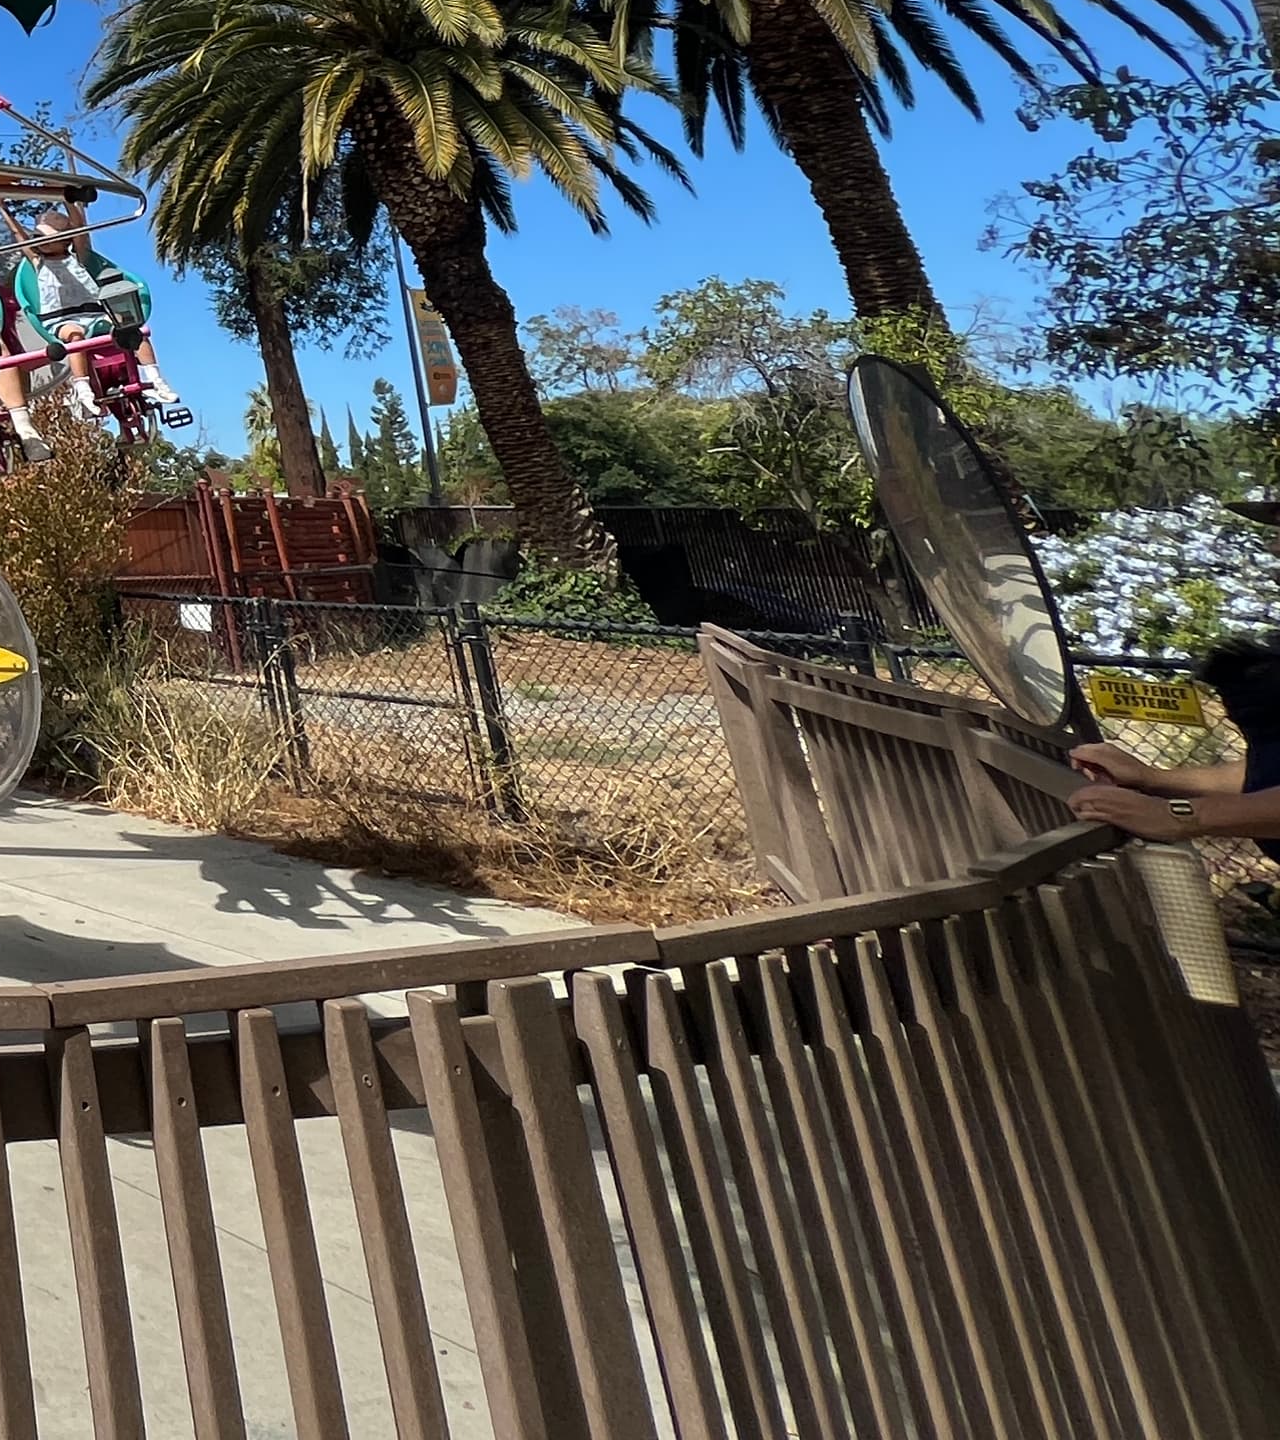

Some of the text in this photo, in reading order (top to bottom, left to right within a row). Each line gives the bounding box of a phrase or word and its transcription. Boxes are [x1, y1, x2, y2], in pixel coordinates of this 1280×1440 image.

[1098, 681, 1189, 700] STEEL FENCE
[1113, 693, 1180, 711] SYSTEMS
